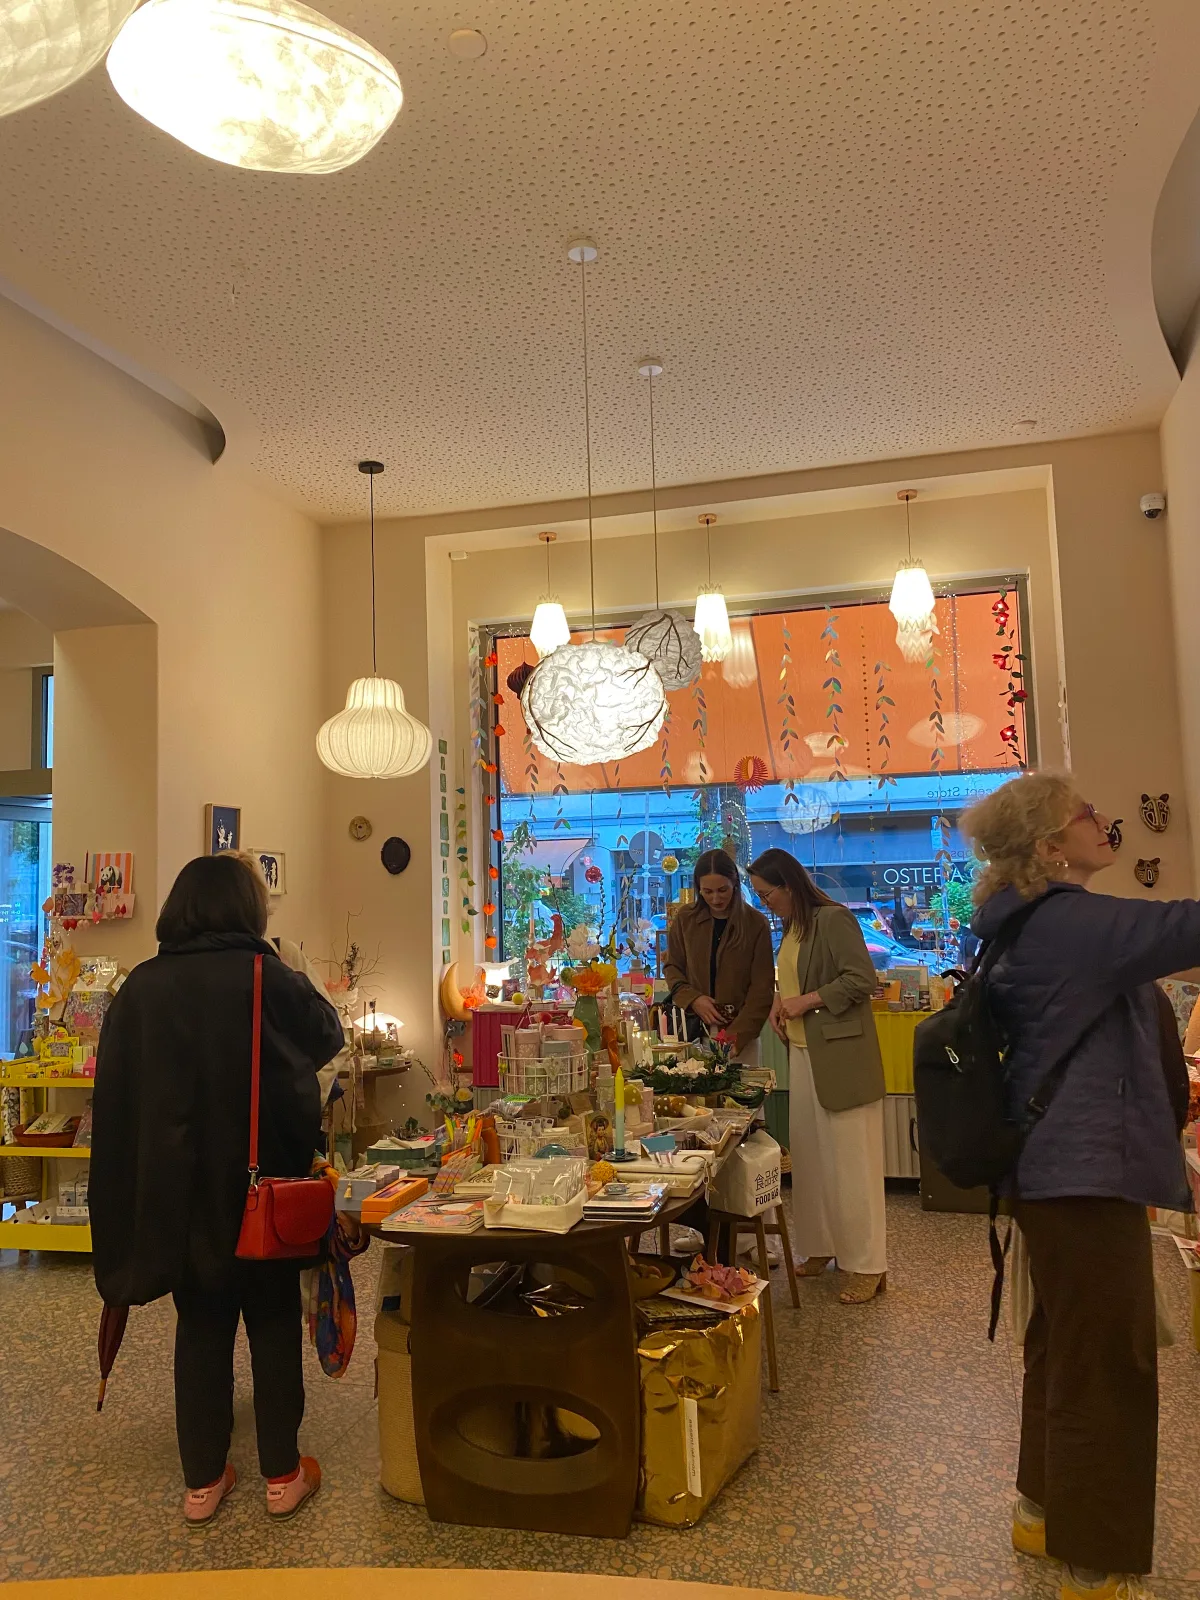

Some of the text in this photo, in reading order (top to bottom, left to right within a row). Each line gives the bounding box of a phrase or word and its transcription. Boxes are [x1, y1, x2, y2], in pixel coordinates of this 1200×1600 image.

[755, 1167, 778, 1191] 食品袋
[755, 1188, 779, 1206] FOOD BAG
